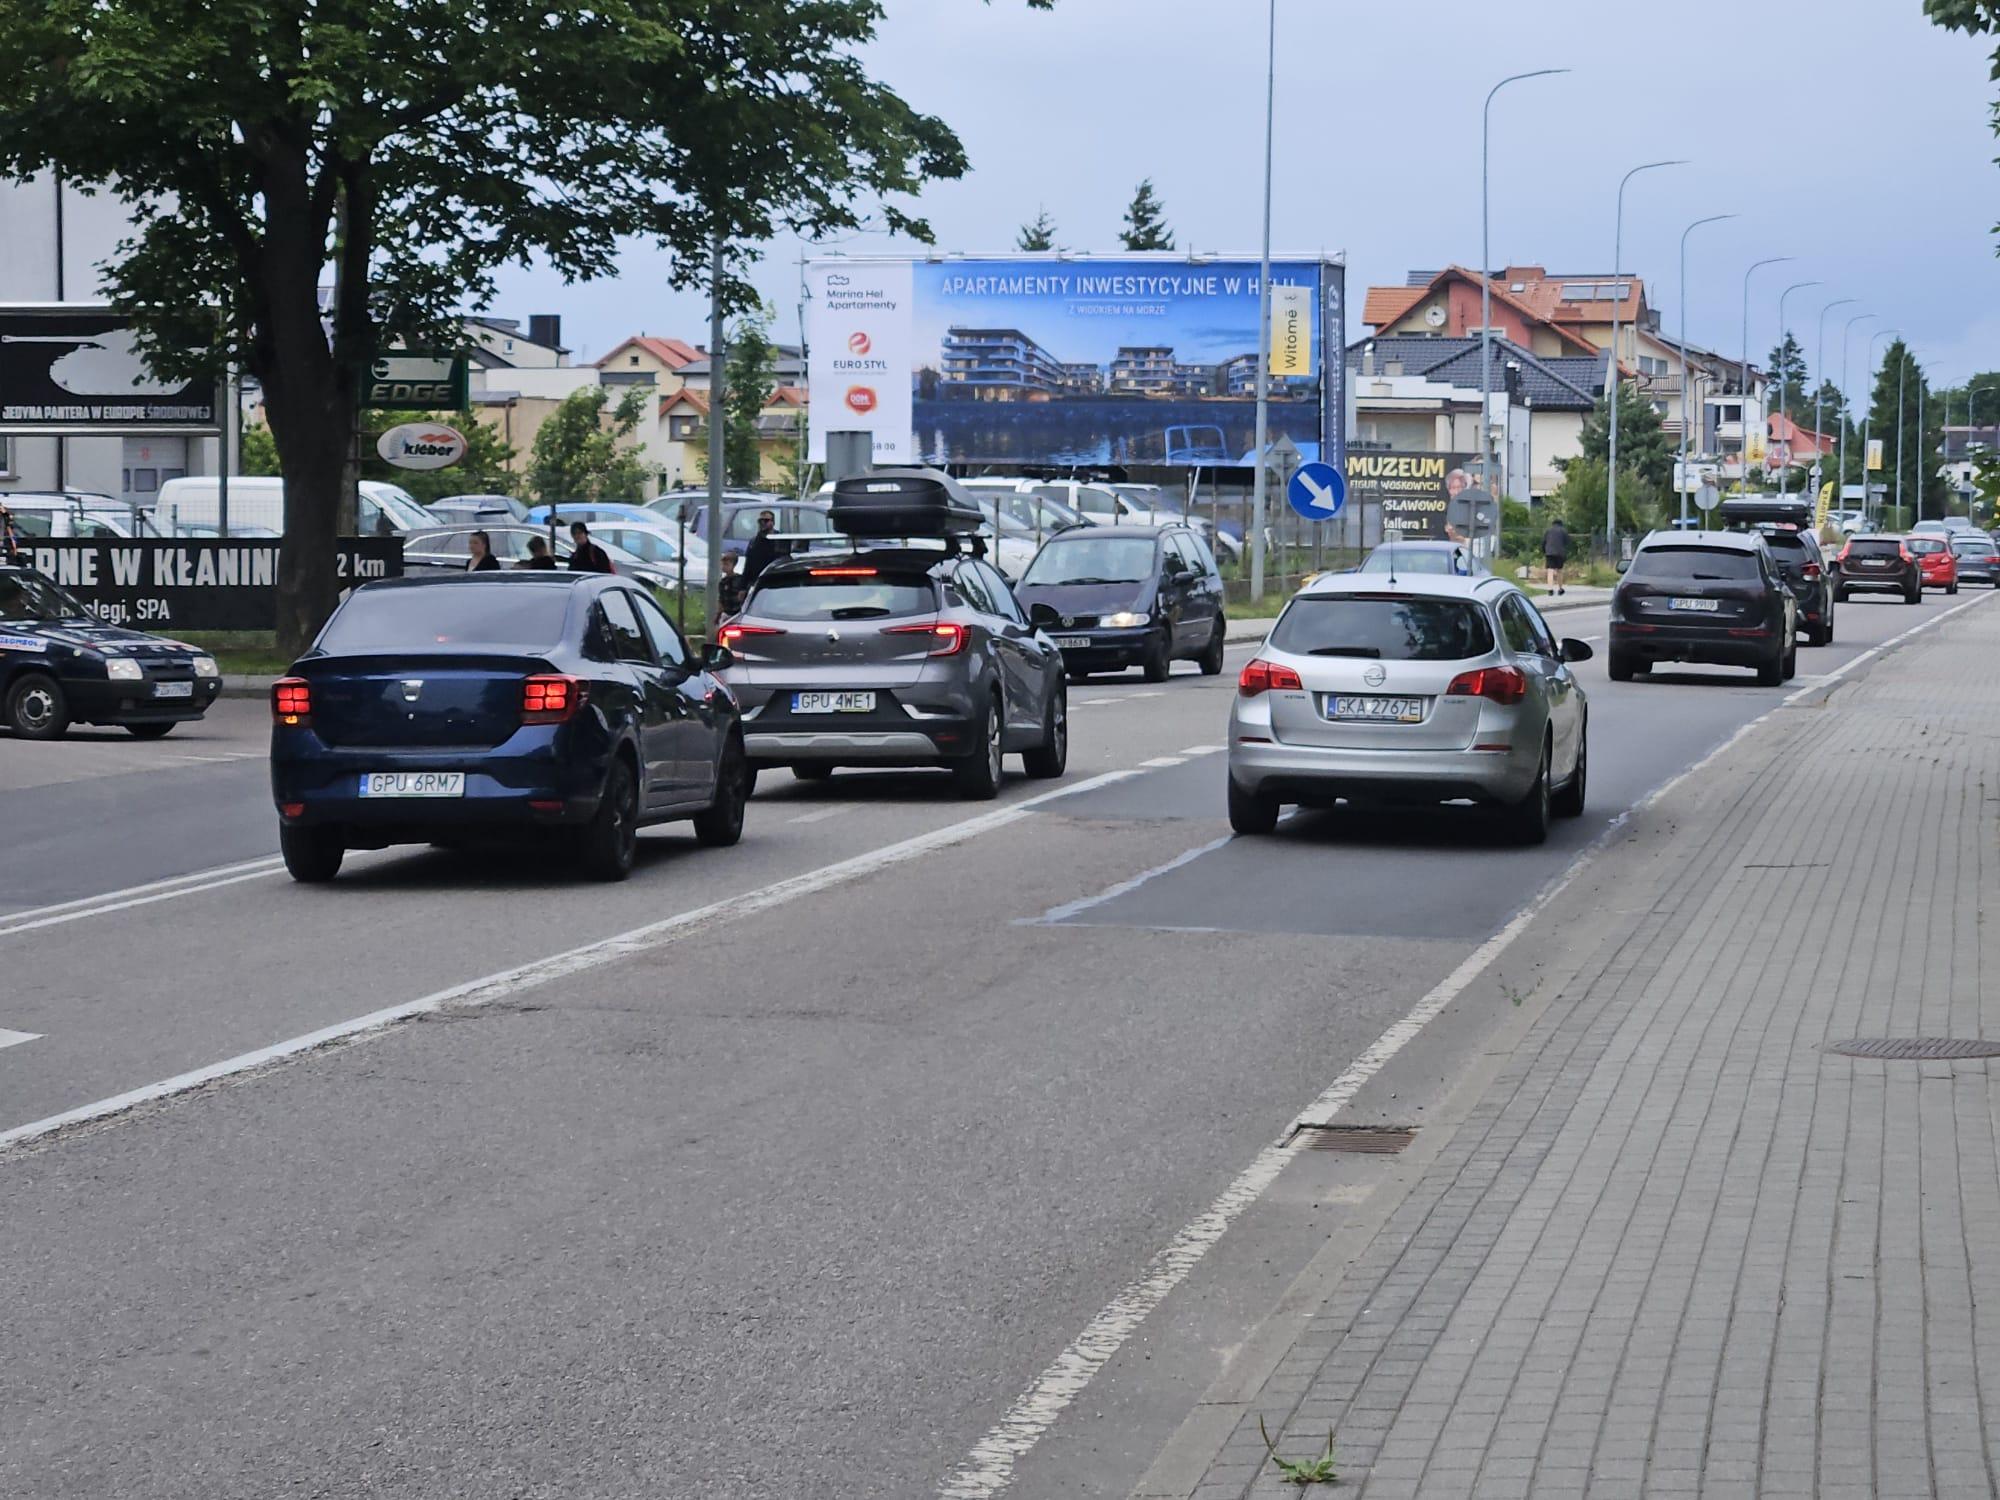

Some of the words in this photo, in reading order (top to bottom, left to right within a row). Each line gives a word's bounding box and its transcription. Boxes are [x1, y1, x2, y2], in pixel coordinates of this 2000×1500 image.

[826, 289, 864, 298] Marina
[866, 289, 884, 298] Hel
[942, 277, 1070, 295] APARTAMENTY
[1076, 276, 1217, 295] INWESTYCYJNE
[1223, 277, 1240, 295] W
[827, 300, 897, 311] Apartamenty
[833, 360, 862, 369] EURO
[864, 360, 888, 369] STYL
[370, 383, 453, 401] EDGE
[2, 405, 43, 419] JEDYNA
[44, 405, 90, 419] PANTERA
[91, 405, 102, 419] W
[103, 405, 146, 419] EUROPIE
[1348, 456, 1445, 479] MUZEUM
[1350, 479, 1378, 490] FIGUR
[1380, 479, 1441, 491] WOSKOWYCH
[111, 548, 142, 586] W
[336, 553, 347, 577] 2
[354, 553, 385, 577] km
[136, 599, 171, 620] SPA
[801, 693, 831, 709] GPU
[835, 693, 871, 709] 4WE1
[1336, 696, 1367, 715] GKA
[1371, 698, 1421, 717] 2767E
[372, 774, 408, 793] GPU
[413, 774, 461, 792] 6RM7
